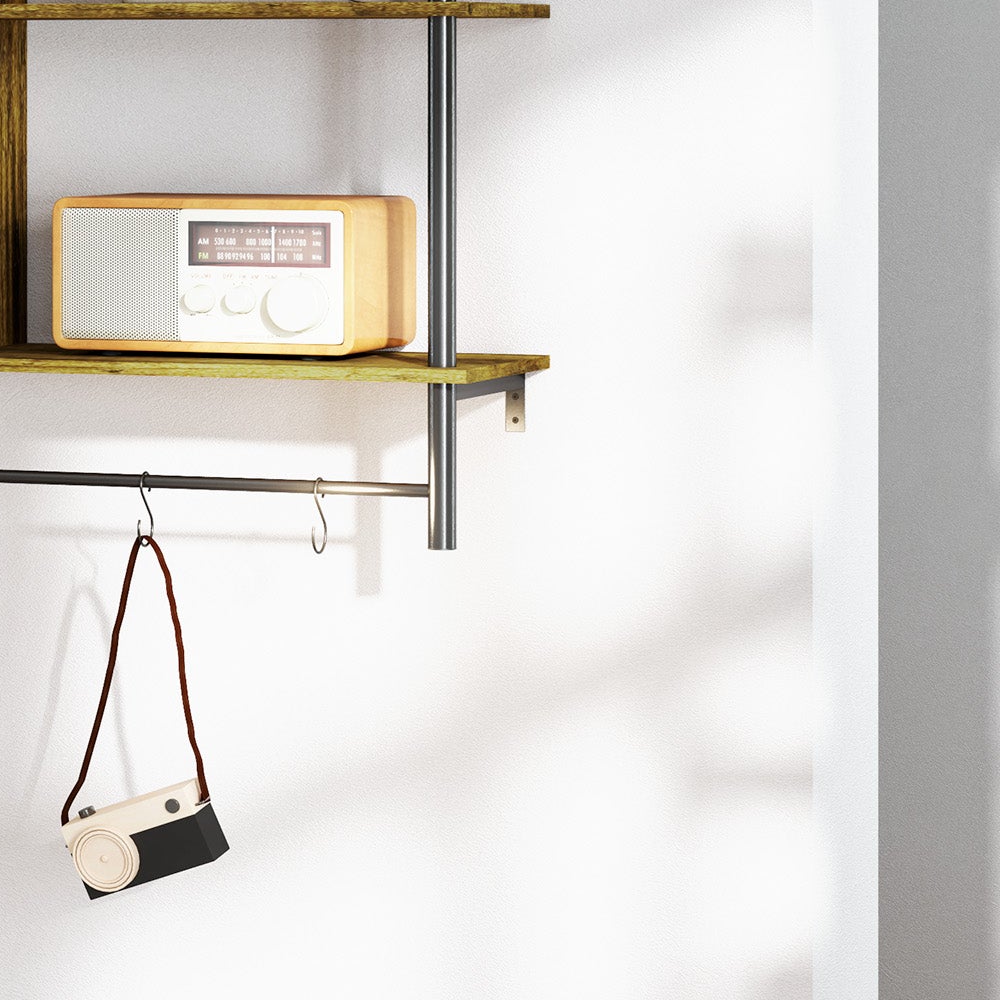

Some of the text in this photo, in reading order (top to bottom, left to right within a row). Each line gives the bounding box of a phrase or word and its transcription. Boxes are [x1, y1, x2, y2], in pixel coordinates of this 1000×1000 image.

[197, 237, 210, 245] AM
[214, 237, 225, 246] 530
[292, 238, 307, 247] 1700
[198, 252, 209, 260] FM
[216, 252, 224, 260] 88
[224, 252, 231, 260] 90
[231, 252, 239, 260] 92
[239, 252, 246, 260] 94
[246, 252, 254, 261] 96
[260, 252, 271, 261] 100
[277, 252, 287, 261] 104
[293, 252, 304, 261] 108
